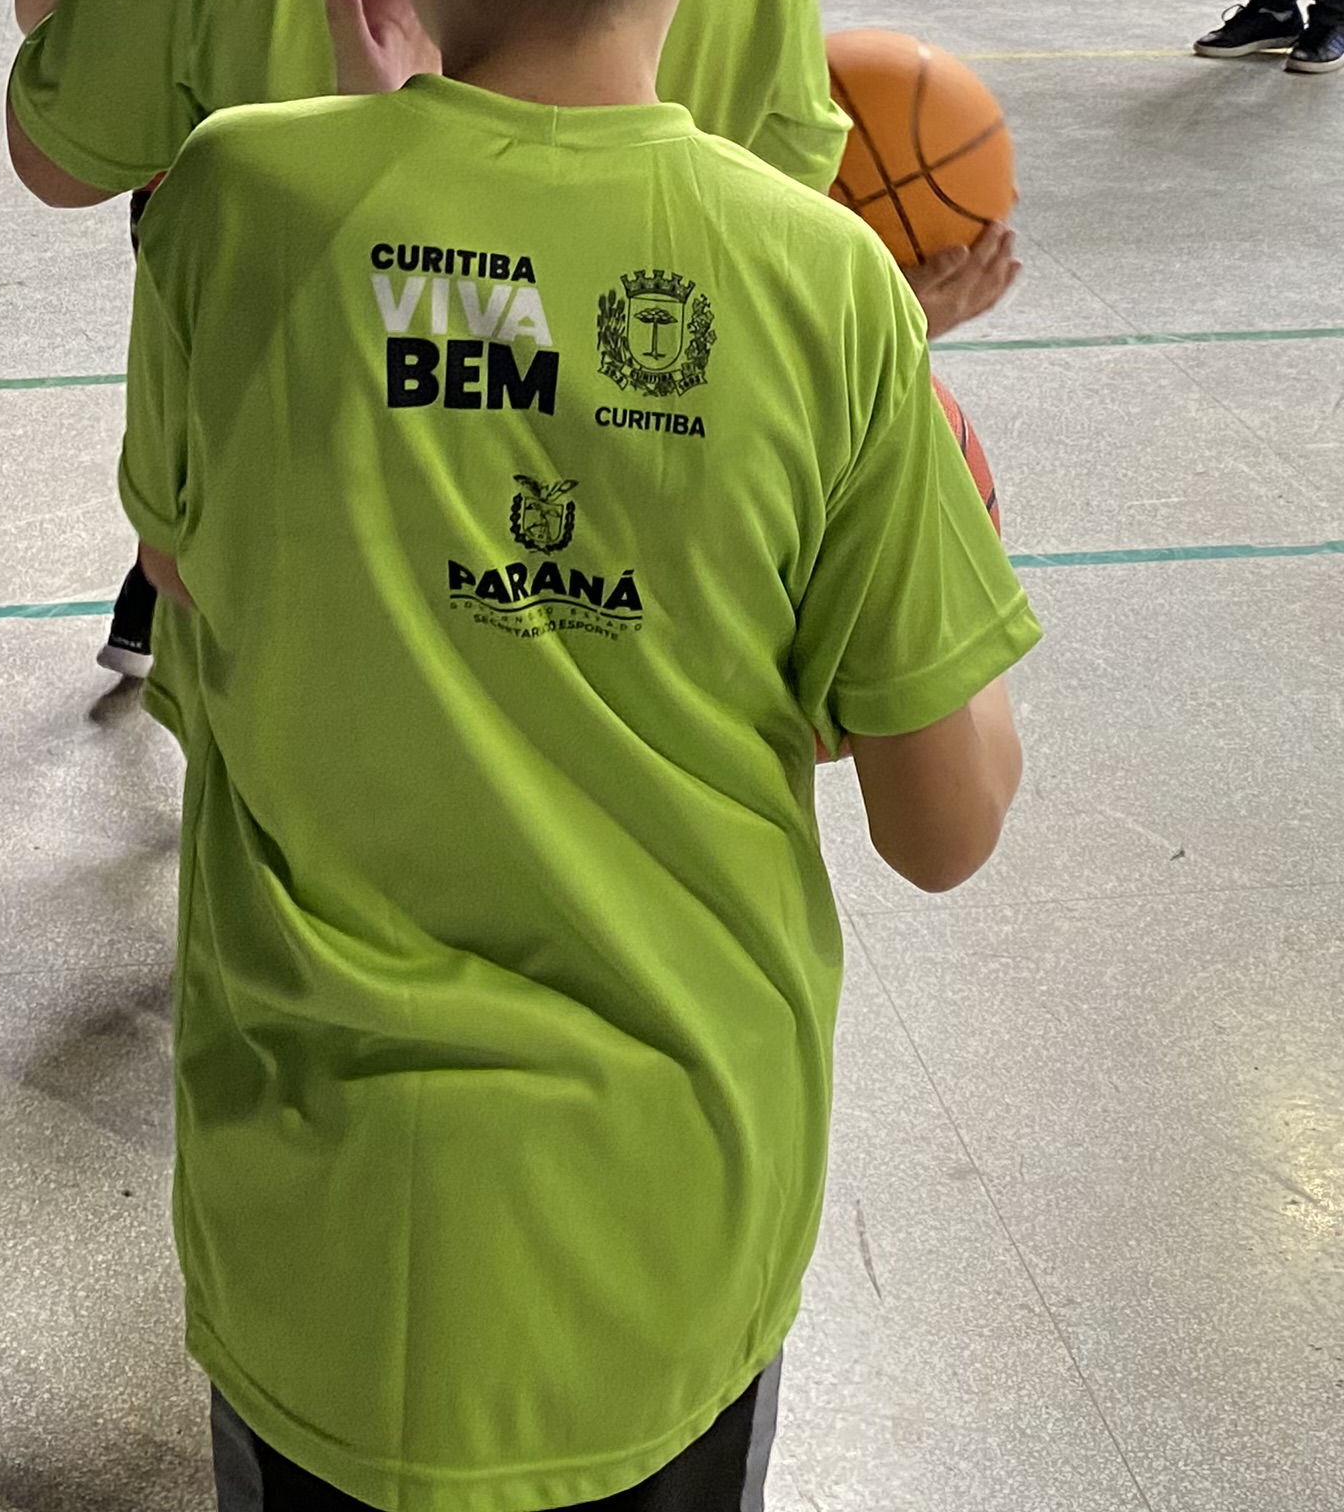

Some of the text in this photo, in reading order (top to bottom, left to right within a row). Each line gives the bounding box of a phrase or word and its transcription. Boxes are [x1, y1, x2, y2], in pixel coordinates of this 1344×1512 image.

[371, 243, 536, 284] CURITIBA
[371, 273, 553, 347] VIVA
[387, 336, 560, 416] BEM
[594, 406, 706, 439] CURITIBA
[448, 559, 643, 611] PARANÁ
